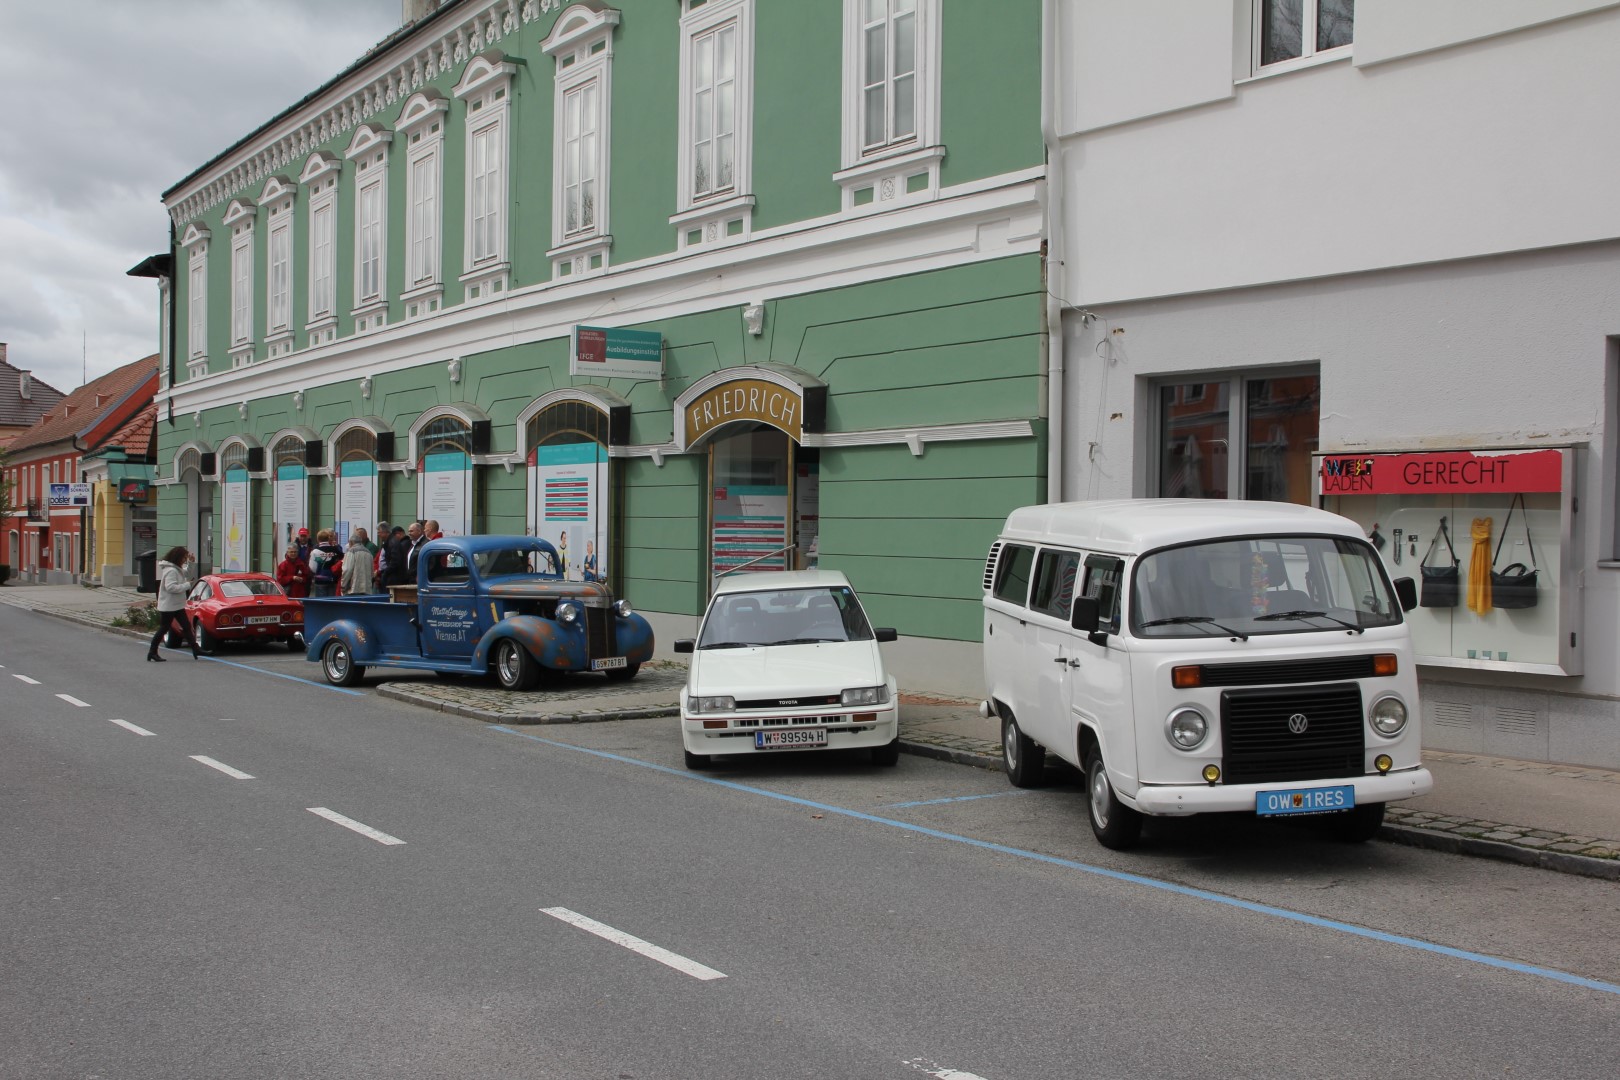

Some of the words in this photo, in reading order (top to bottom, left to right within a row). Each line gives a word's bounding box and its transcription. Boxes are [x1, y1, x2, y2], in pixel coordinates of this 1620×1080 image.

[606, 346, 660, 356] Ausbildungsinstitut
[693, 387, 795, 431] FRIEDRICH
[1325, 458, 1375, 476] WELT
[1403, 460, 1510, 485] GERECHT
[1325, 475, 1373, 491] LADEN
[596, 660, 604, 669] GS
[764, 733, 773, 744] W
[780, 731, 815, 744] 99594
[816, 730, 824, 742] H
[1268, 793, 1291, 811] OW
[1304, 790, 1345, 809] 1RES
